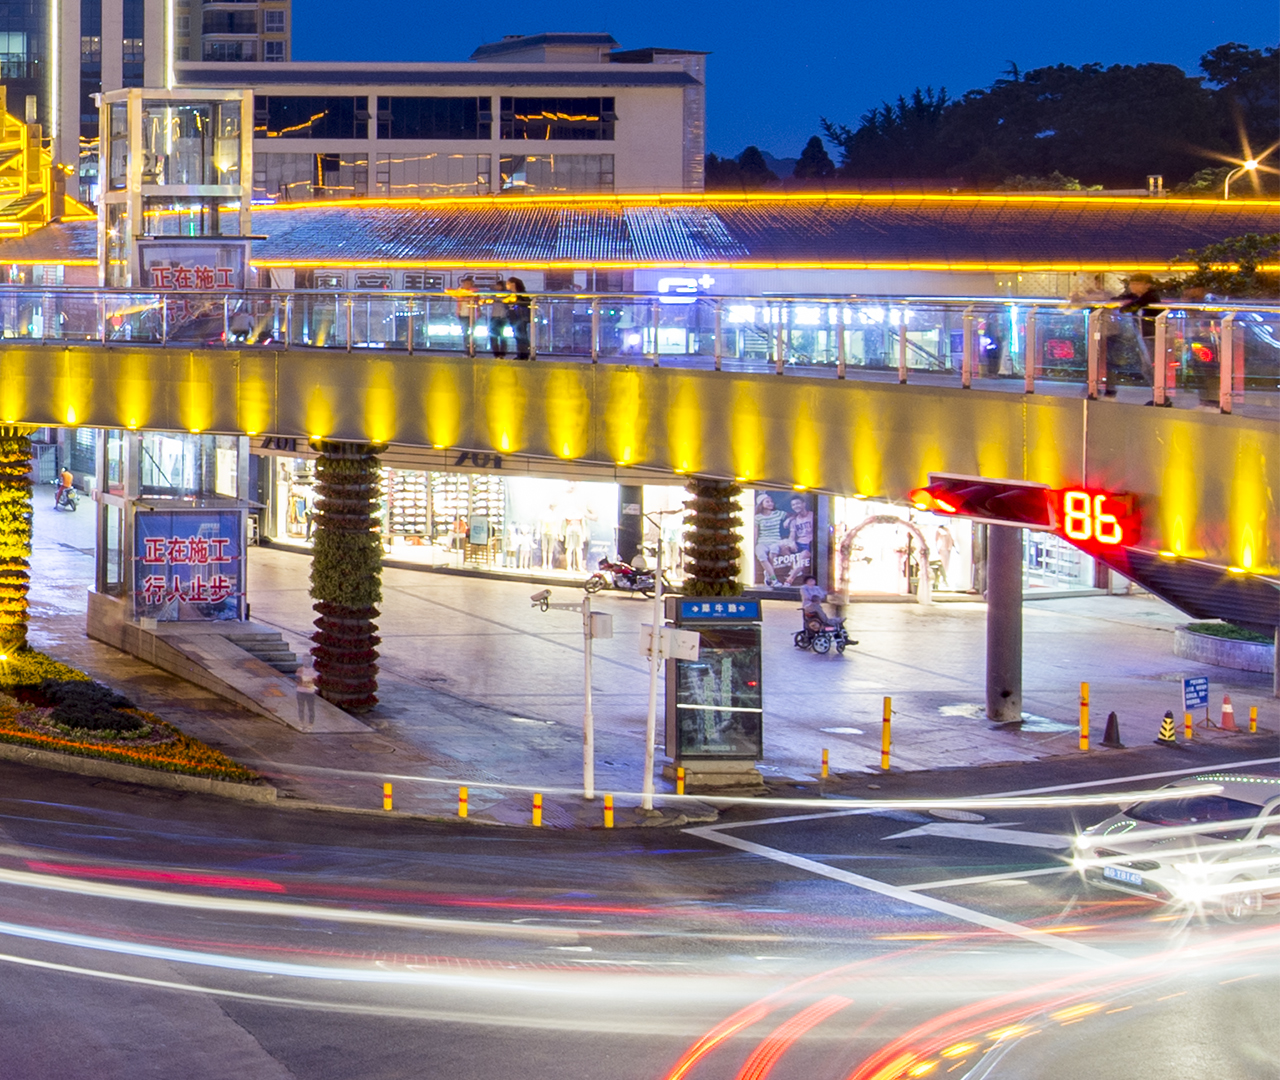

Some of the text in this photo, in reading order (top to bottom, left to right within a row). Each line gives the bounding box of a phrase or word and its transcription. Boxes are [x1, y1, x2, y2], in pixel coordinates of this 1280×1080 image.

[150, 265, 235, 290] 正在施工
[1064, 490, 1123, 544] 86
[143, 536, 231, 565] 正在施工
[773, 553, 801, 567] SPORT
[144, 575, 231, 605] 行人止步
